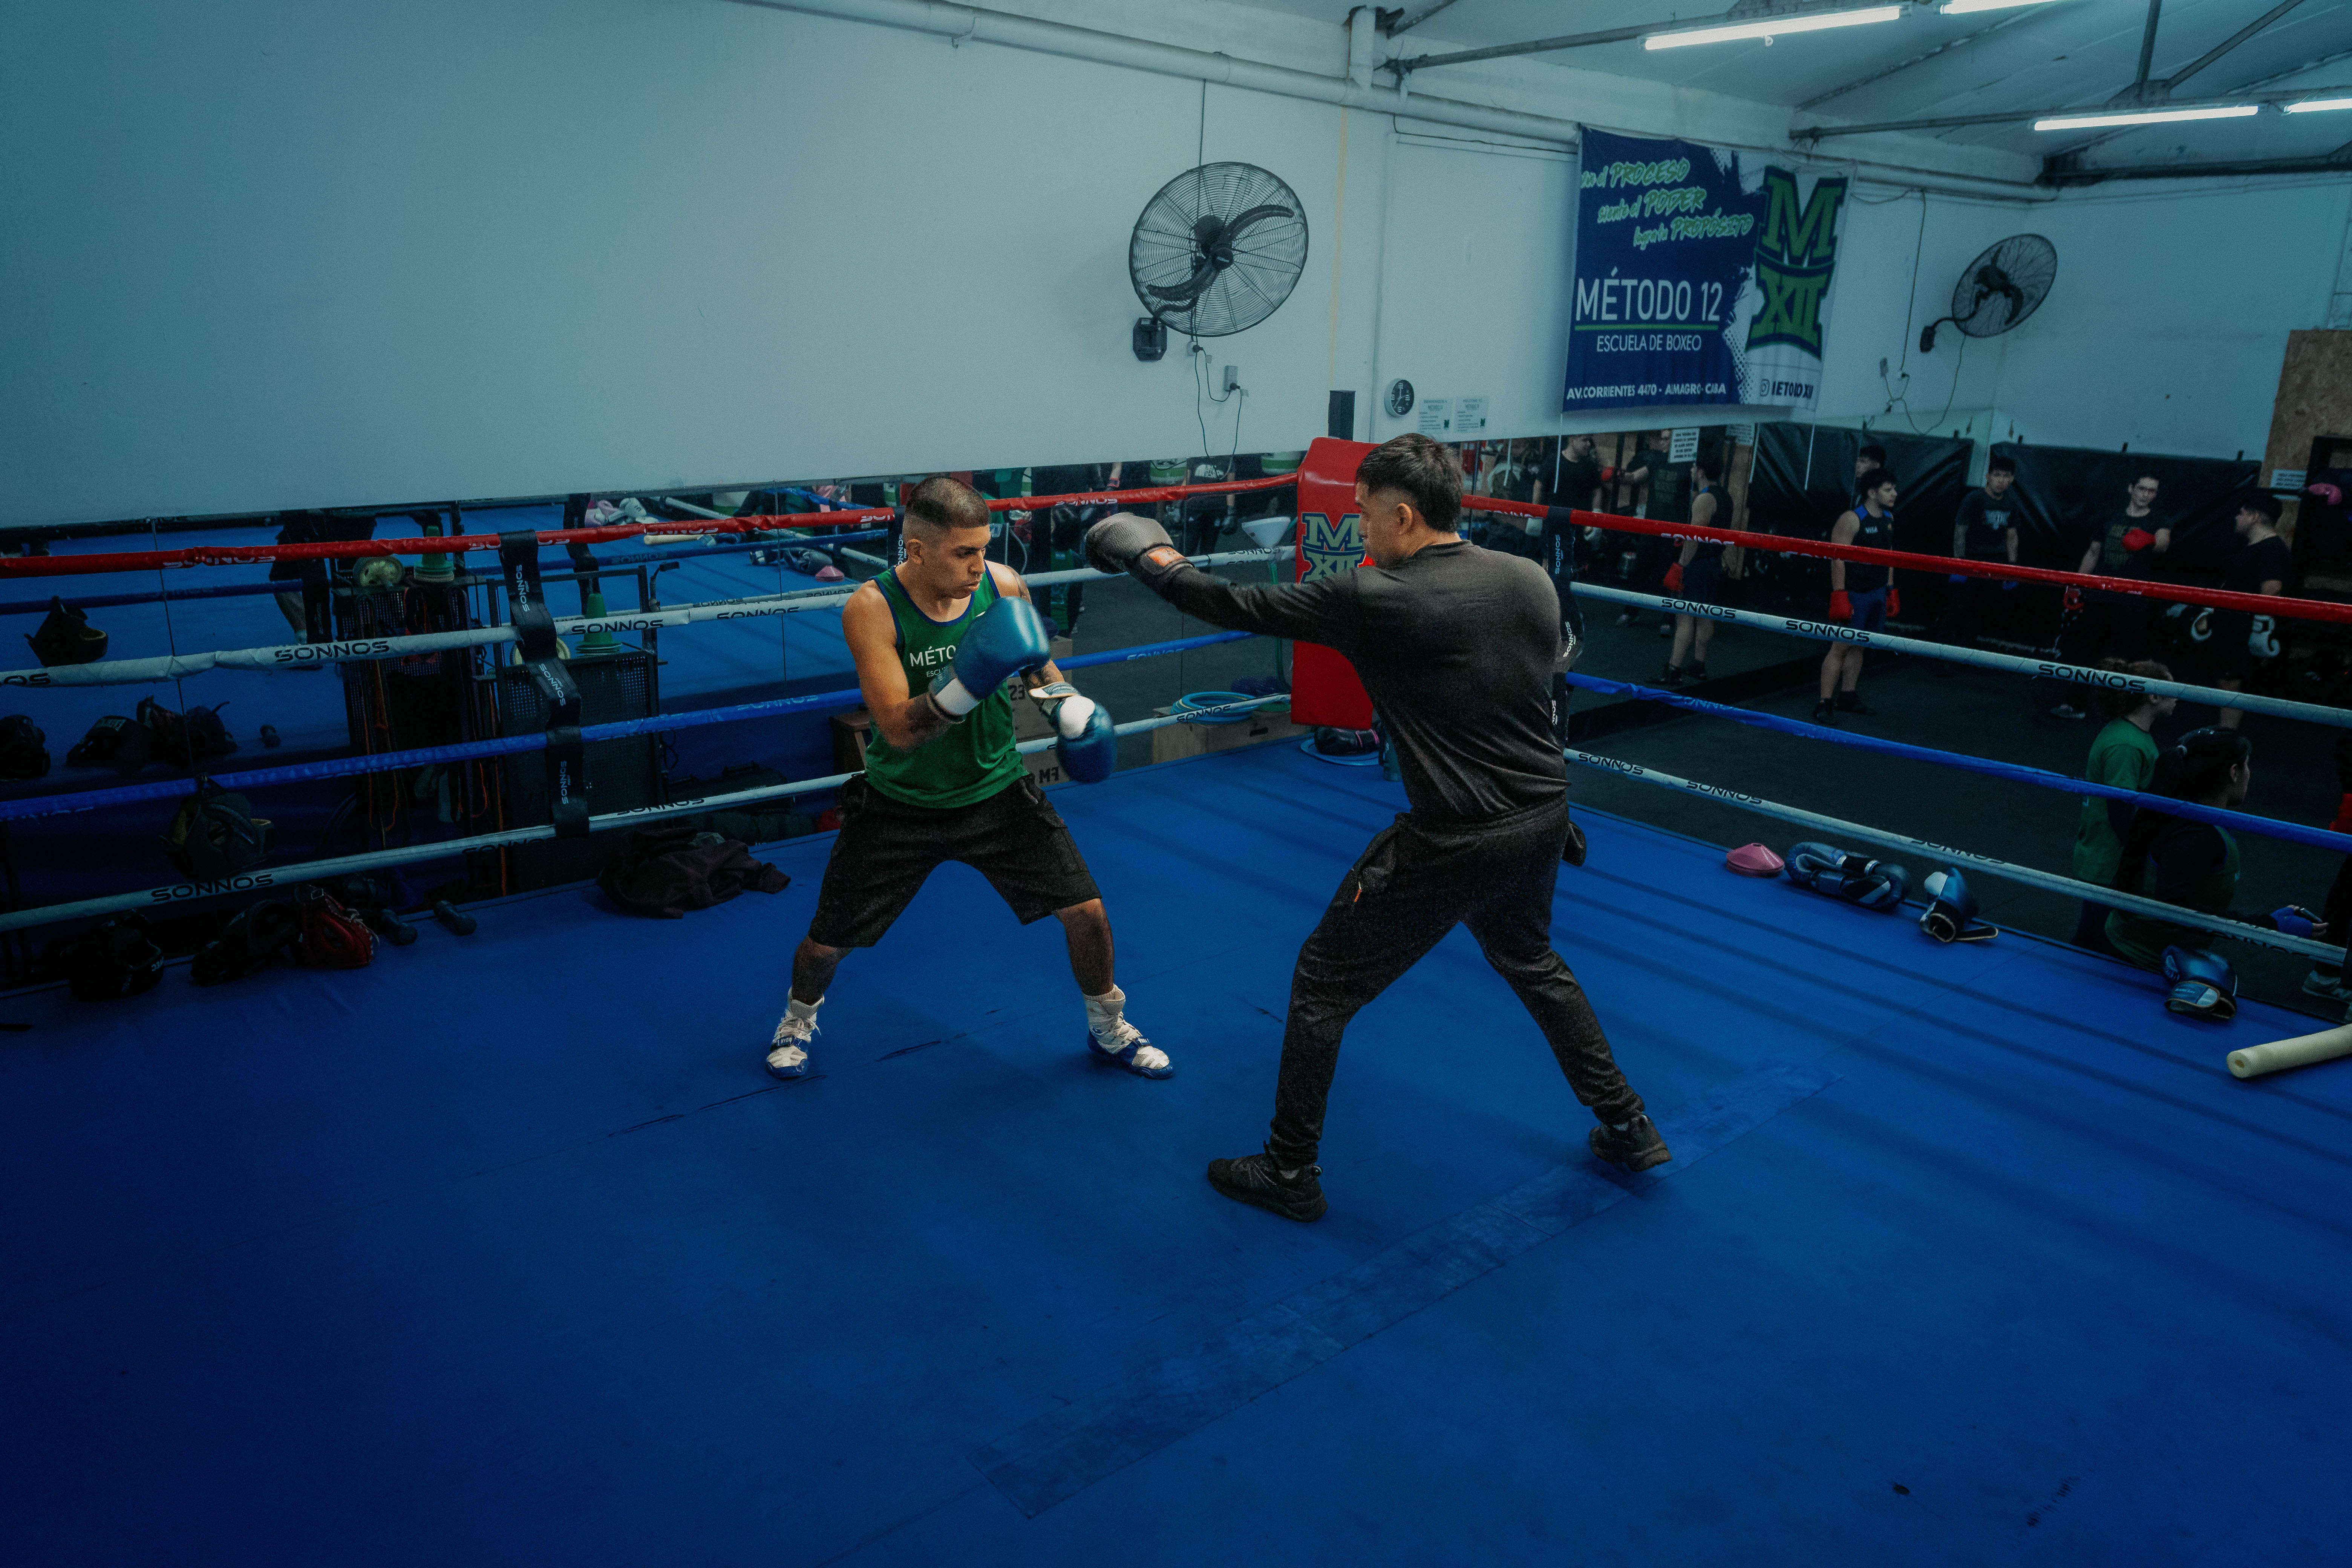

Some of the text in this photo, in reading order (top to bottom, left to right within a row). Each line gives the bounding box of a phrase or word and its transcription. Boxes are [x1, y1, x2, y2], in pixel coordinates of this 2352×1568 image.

[1609, 157, 1690, 188] PROCESO
[1643, 186, 1707, 217] PODER
[1576, 266, 1723, 321] MÉTODO 12
[1597, 334, 1702, 352] ESCUELA DE BOXEO
[516, 565, 530, 612] SONNOS
[1661, 599, 1736, 619] SONNOS
[571, 619, 664, 635] SONNOS
[1785, 620, 1870, 642] SONNOS
[275, 641, 390, 662] SONNOS
[539, 663, 566, 707] SONNOS
[2038, 664, 2146, 691] SONNOS
[1579, 753, 1644, 775] SONNOS
[559, 760, 569, 805] SONNOS
[1686, 780, 1762, 804] SONNOS
[152, 874, 273, 902] SONNOS
